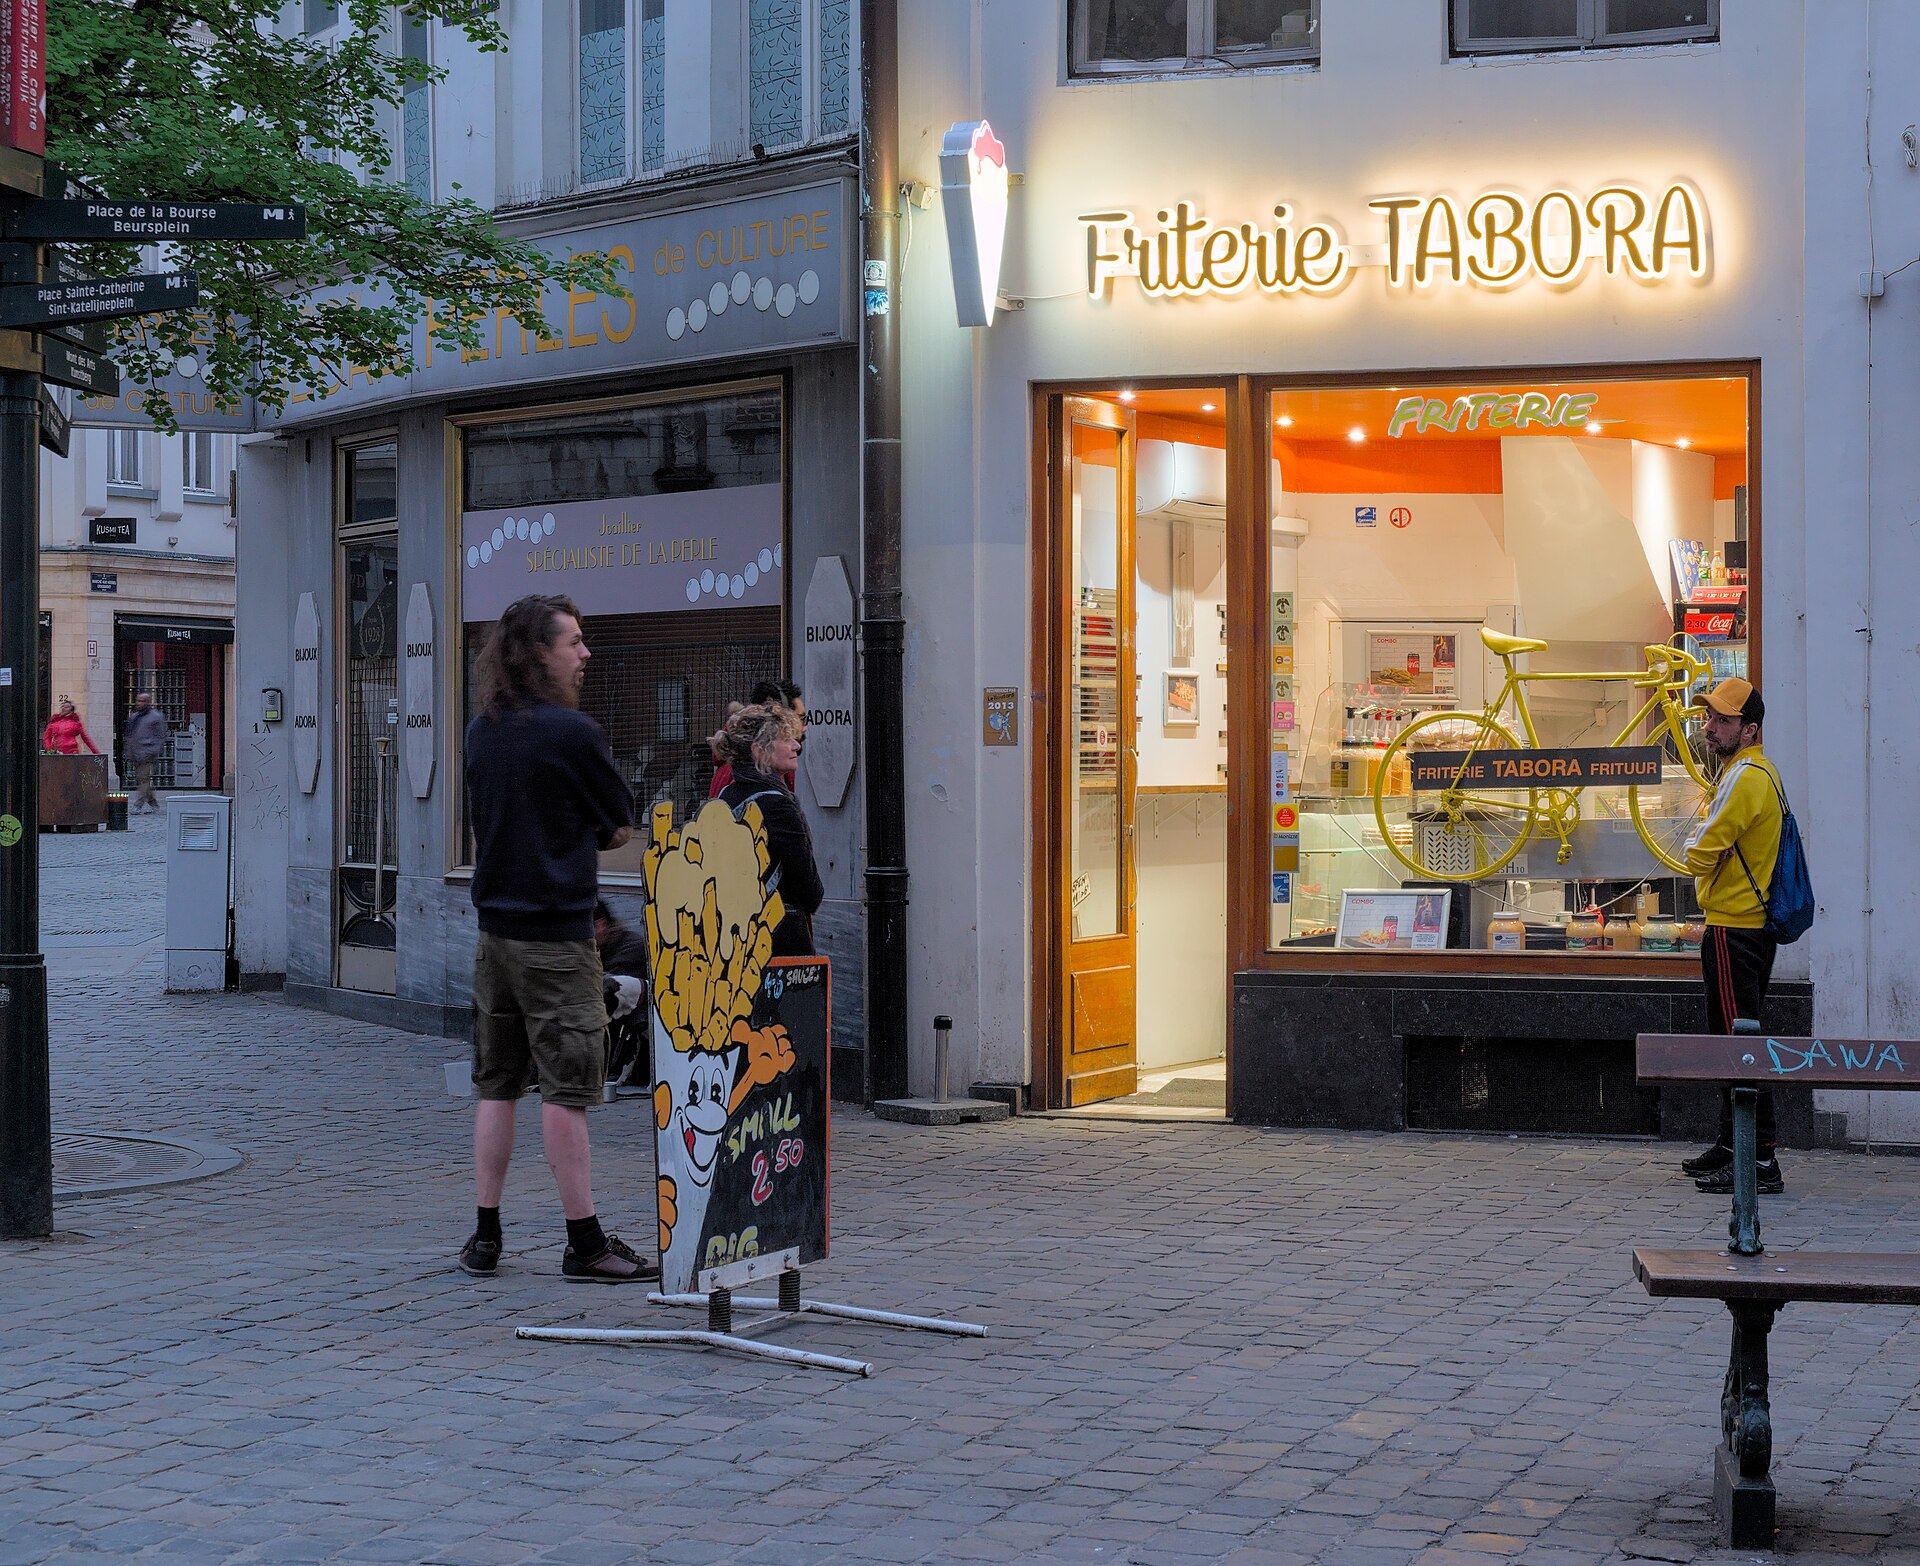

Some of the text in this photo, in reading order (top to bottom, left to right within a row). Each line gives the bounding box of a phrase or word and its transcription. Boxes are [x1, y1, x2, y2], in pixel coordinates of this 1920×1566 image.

[29, 78, 38, 130] Centre
[87, 205, 123, 218] Place
[129, 205, 145, 217] de
[152, 206, 163, 218] la
[169, 206, 217, 219] Bourse
[113, 220, 190, 235] Beursplein
[653, 239, 686, 276] de
[696, 211, 829, 270] CULTURE
[1078, 186, 1705, 298] Friterie TABORA
[38, 288, 62, 301] Place
[66, 281, 145, 299] Sainte-Catherine
[48, 297, 134, 316] Sint-Katelijneplein
[1388, 392, 1598, 438] FRITERIE
[96, 524, 130, 535] KUSMI TEA
[599, 511, 642, 536] Joaillier
[526, 536, 719, 574] SPÉCIALISTE DE LA PERLE
[167, 628, 191, 640] KUSMI TEA
[806, 624, 852, 642] BIJOUX
[295, 649, 318, 662] BIJOUX
[407, 642, 432, 657] BIJOUX
[59, 694, 69, 702] 22
[987, 702, 1015, 710] 2013
[295, 715, 317, 729] ADORA
[406, 714, 432, 729] ADORA
[805, 709, 852, 726] ADORA
[1418, 758, 1657, 780] FRITERIE TABORA FRITUUR
[1766, 1038, 1906, 1075] DAWA
[727, 1091, 801, 1164] SMALL
